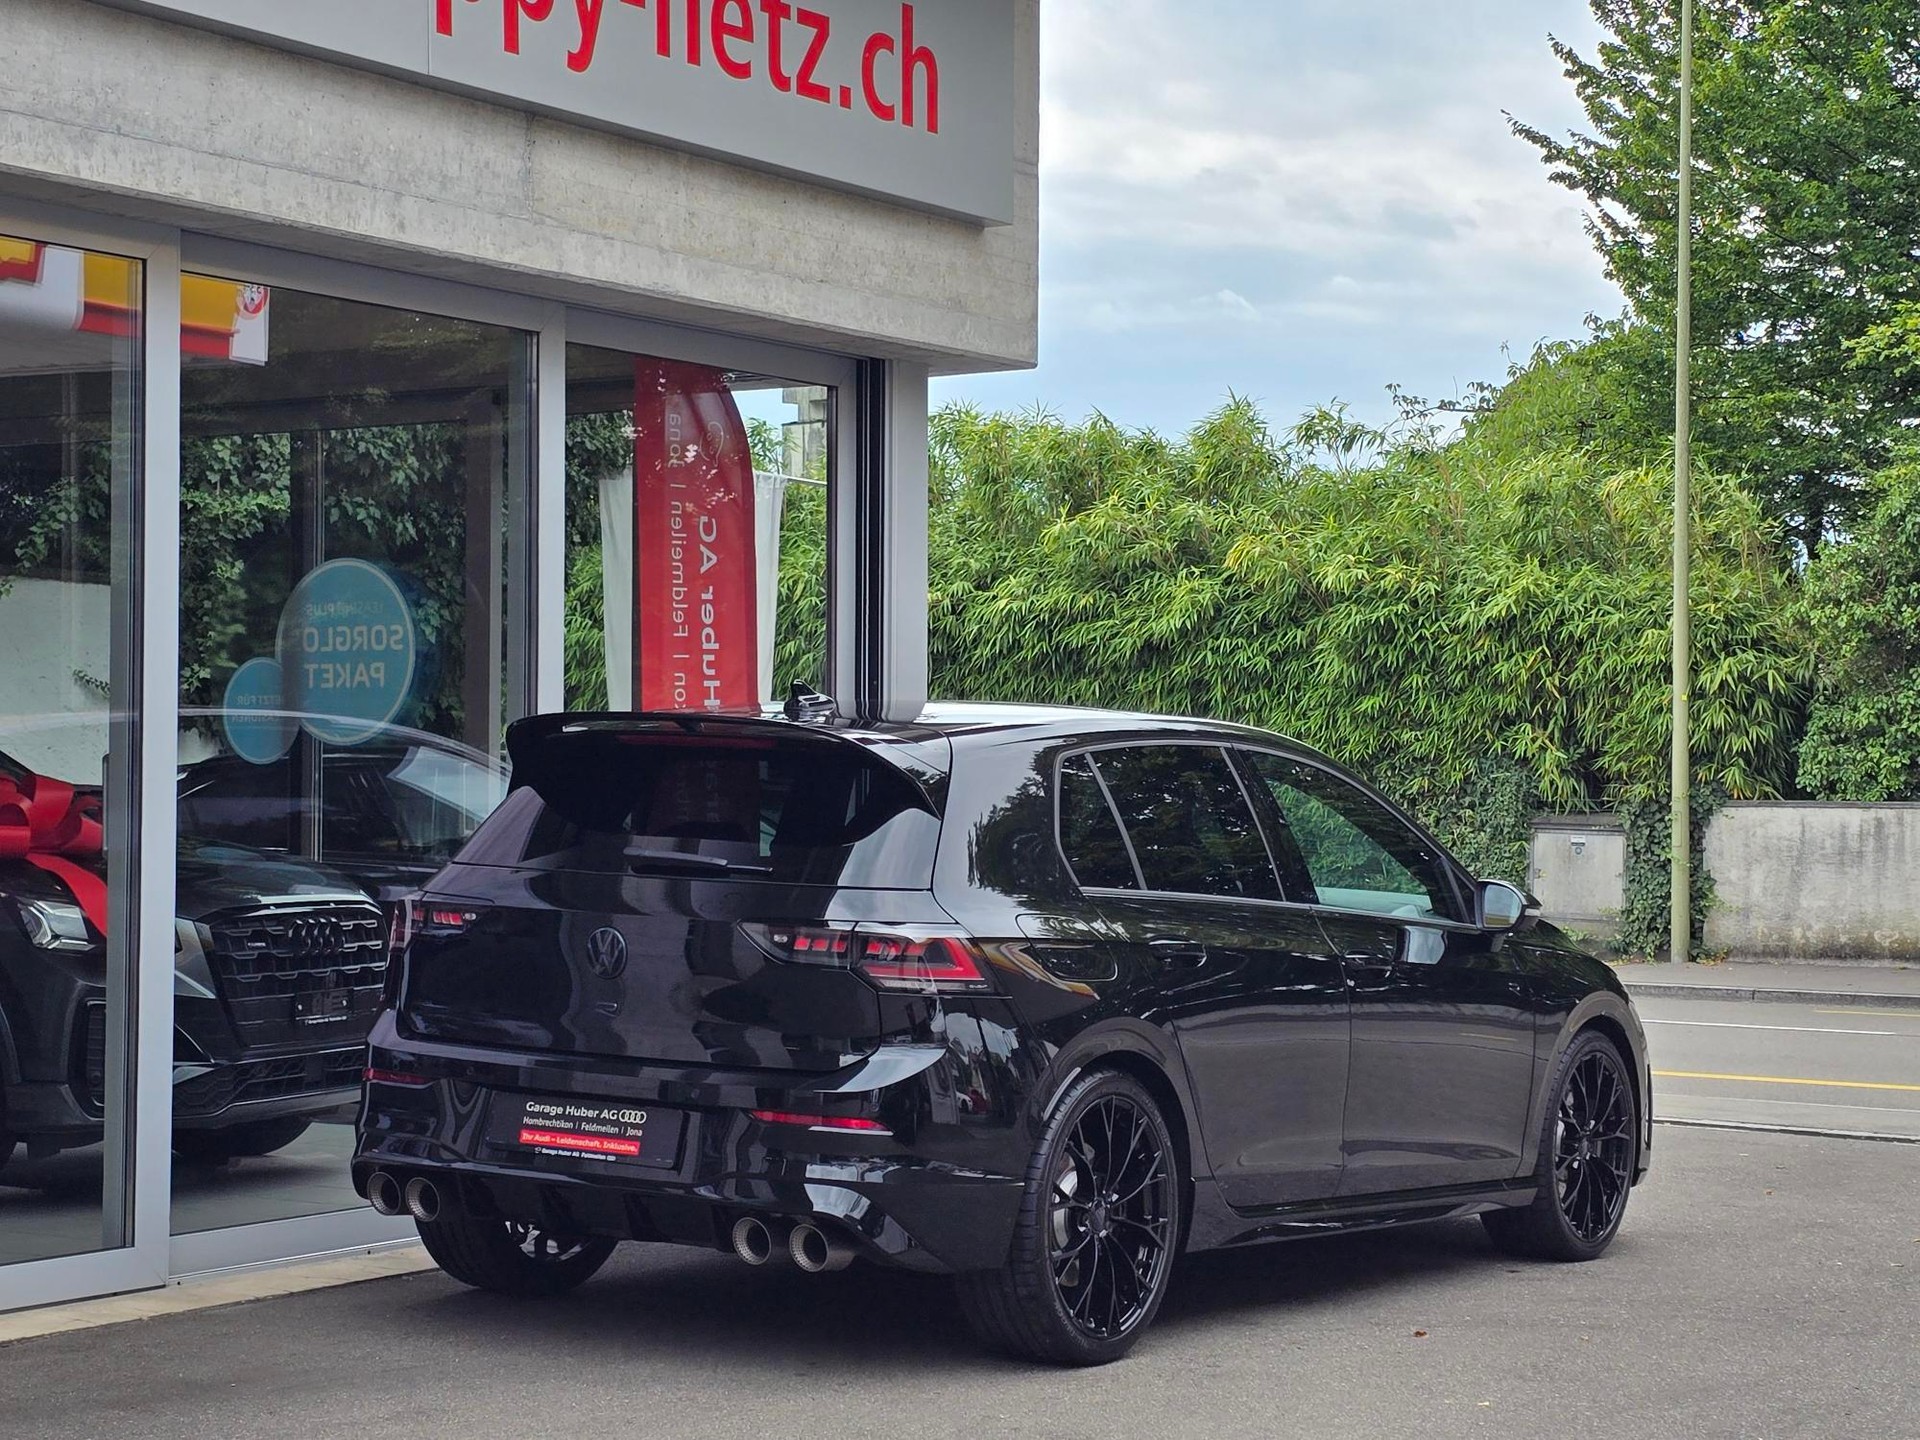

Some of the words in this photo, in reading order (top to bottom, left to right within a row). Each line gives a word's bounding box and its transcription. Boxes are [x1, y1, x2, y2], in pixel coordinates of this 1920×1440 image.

[525, 1101, 564, 1116] Garage
[565, 1105, 600, 1118] Huber
[600, 1109, 618, 1120] AG
[522, 1116, 574, 1129] Hombrechtikon
[581, 1122, 619, 1134] Feldmeilen
[626, 1127, 643, 1136] Jona
